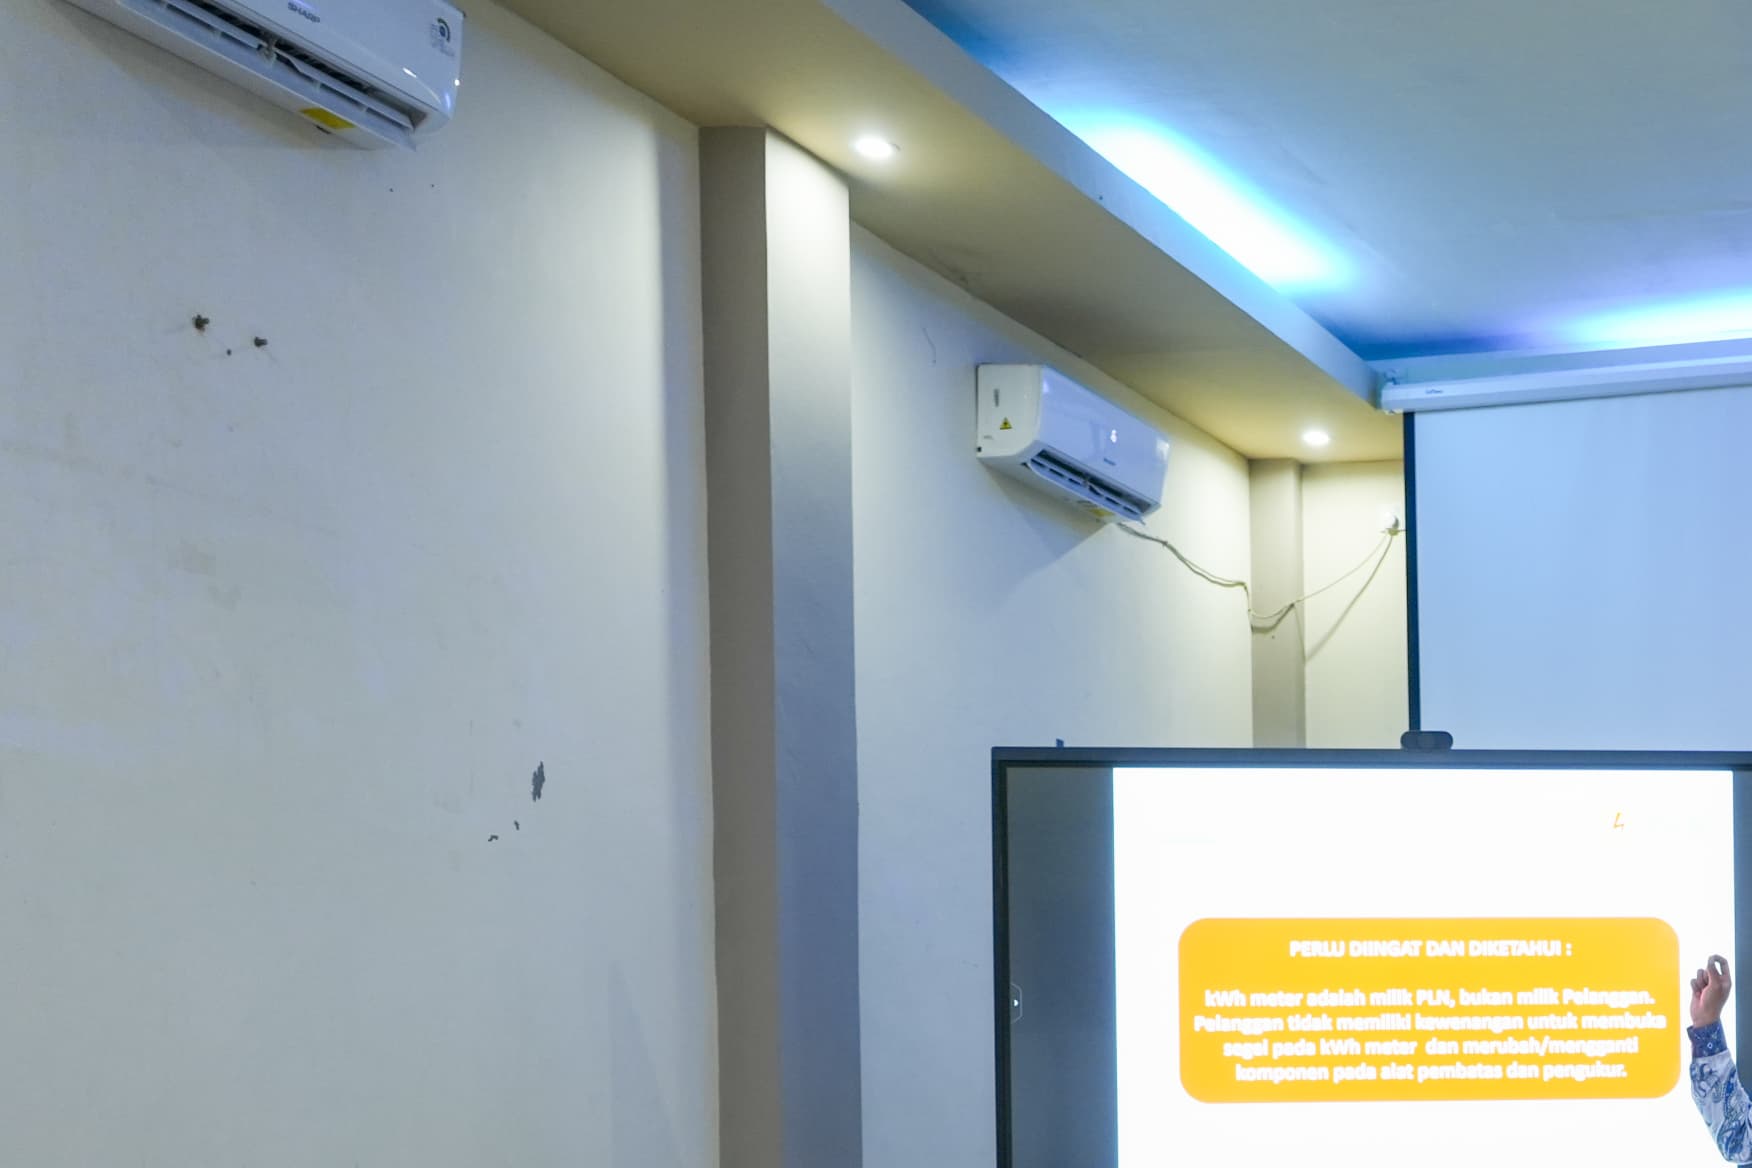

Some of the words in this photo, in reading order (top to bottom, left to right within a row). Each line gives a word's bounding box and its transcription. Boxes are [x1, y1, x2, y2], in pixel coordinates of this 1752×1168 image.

[287, 1, 321, 23] SHARP
[1290, 940, 1345, 957] PERLU
[1349, 940, 1423, 957] DIINGAT
[1426, 940, 1465, 956] DAN
[1469, 940, 1562, 956] DIKETAHUI
[1205, 989, 1246, 1007] kWh
[1250, 991, 1304, 1007] meter
[1306, 989, 1366, 1006] adalah
[1369, 989, 1413, 1006] milik
[1416, 989, 1455, 1008] PLN,
[1460, 988, 1513, 1005] bukan
[1517, 988, 1559, 1005] milik
[1562, 988, 1656, 1008] Pelanggan.
[1194, 1014, 1284, 1035] Pelanggan
[1287, 1013, 1333, 1031] tidak
[1336, 1013, 1411, 1031] memiliki
[1415, 1013, 1524, 1033] kewenangan
[1527, 1012, 1578, 1029] untuk
[1581, 1011, 1667, 1029] membuka
[1223, 1039, 1269, 1060] segel
[1272, 1038, 1316, 1059] pada
[1320, 1038, 1361, 1055] kWh
[1365, 1039, 1418, 1055] meter
[1425, 1037, 1459, 1054] dan
[1235, 1063, 1330, 1084] komponen
[1332, 1062, 1377, 1084] pada
[1380, 1062, 1413, 1080] alat
[1417, 1062, 1503, 1083] pembatas
[1506, 1061, 1539, 1078] dan
[1543, 1061, 1628, 1081] pengukur.
